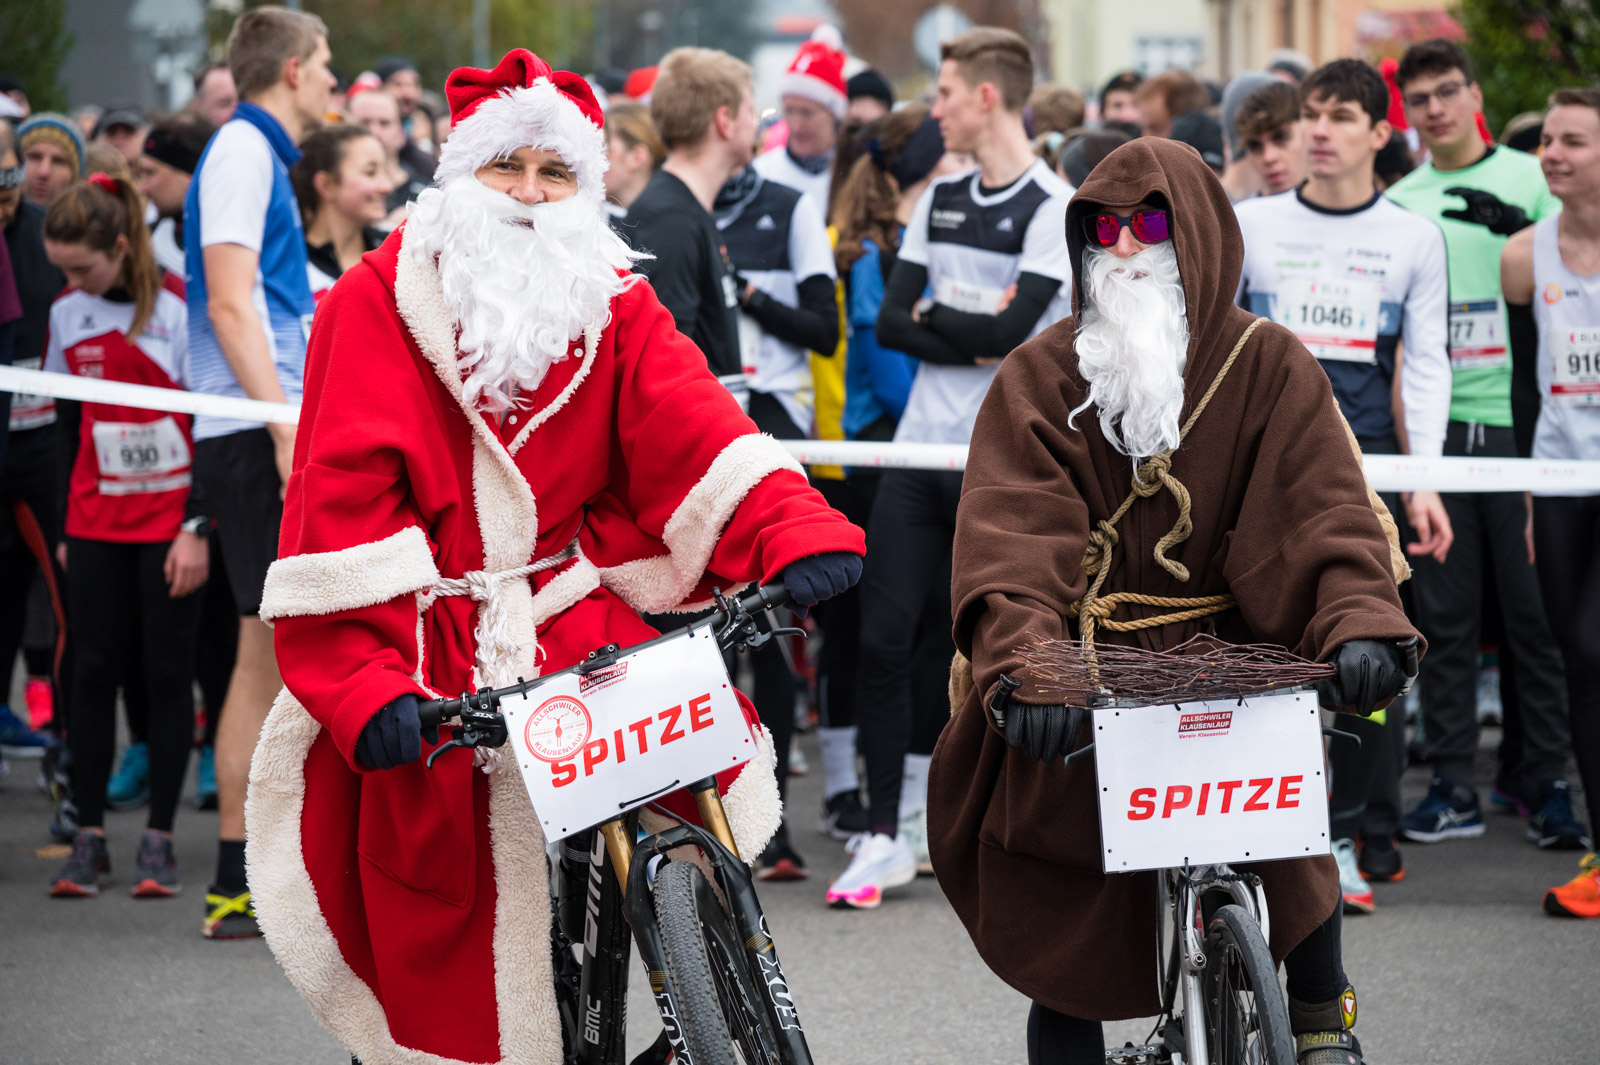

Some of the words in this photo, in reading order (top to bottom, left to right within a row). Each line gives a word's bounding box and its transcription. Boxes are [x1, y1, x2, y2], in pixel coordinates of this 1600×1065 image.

[1300, 304, 1353, 328] 1046
[120, 445, 160, 468] 930
[581, 668, 626, 691] KLAUSENLAUF
[472, 712, 494, 720] SLX
[533, 702, 582, 727] ALLSCHWILER
[1180, 721, 1230, 731] KLAUSENLAUF
[1181, 713, 1231, 722] ALLSCHWILER
[534, 732, 584, 756] KLAUSENLAUF
[551, 692, 714, 788] SPITZE
[1197, 730, 1230, 738] Klausenlauf
[1127, 775, 1303, 821] SPITZE
[583, 994, 602, 1045] BMC
[1302, 1031, 1340, 1044] Nalini
